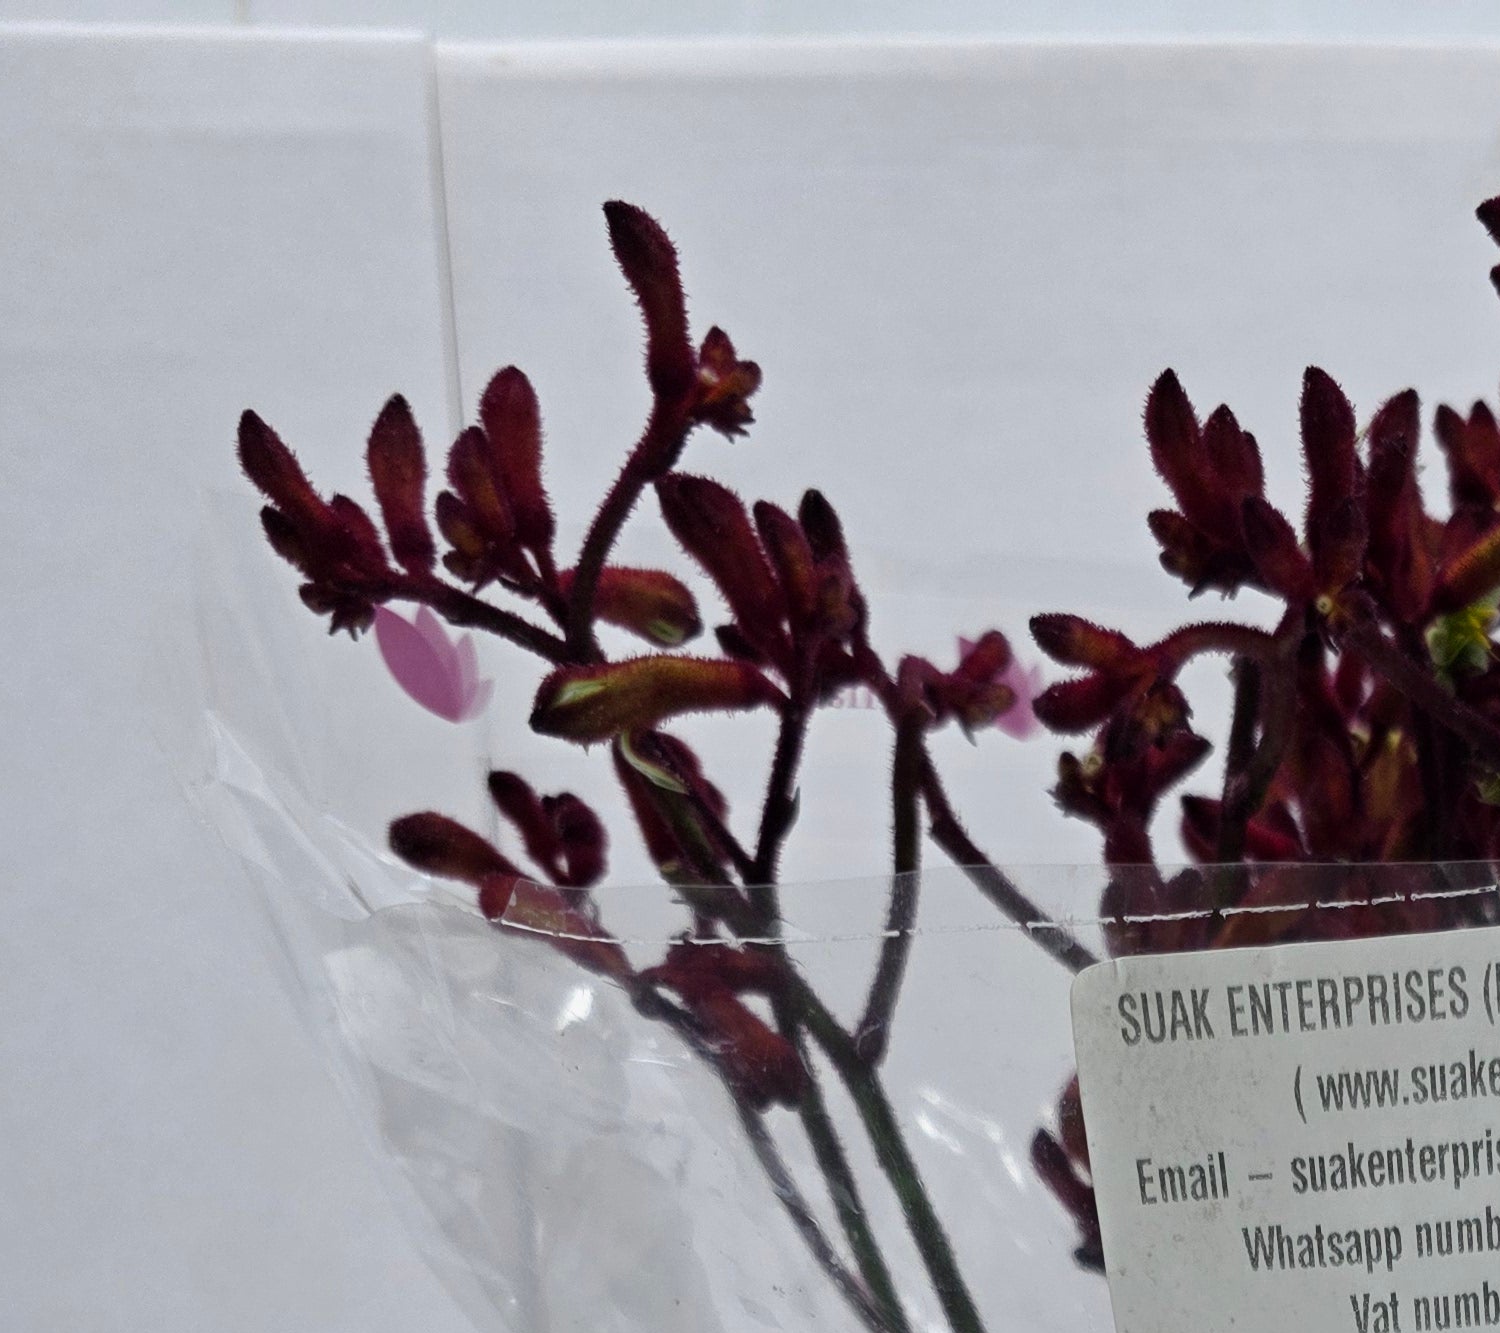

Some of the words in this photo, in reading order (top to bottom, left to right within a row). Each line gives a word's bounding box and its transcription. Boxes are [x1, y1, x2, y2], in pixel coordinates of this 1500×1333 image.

[1118, 989, 1214, 1046] SUAK
[1227, 966, 1469, 1036] ENTERPRISES
[1294, 1066, 1306, 1124] (
[1136, 1152, 1228, 1204] Email
[1242, 1224, 1402, 1273] Whatsapp
